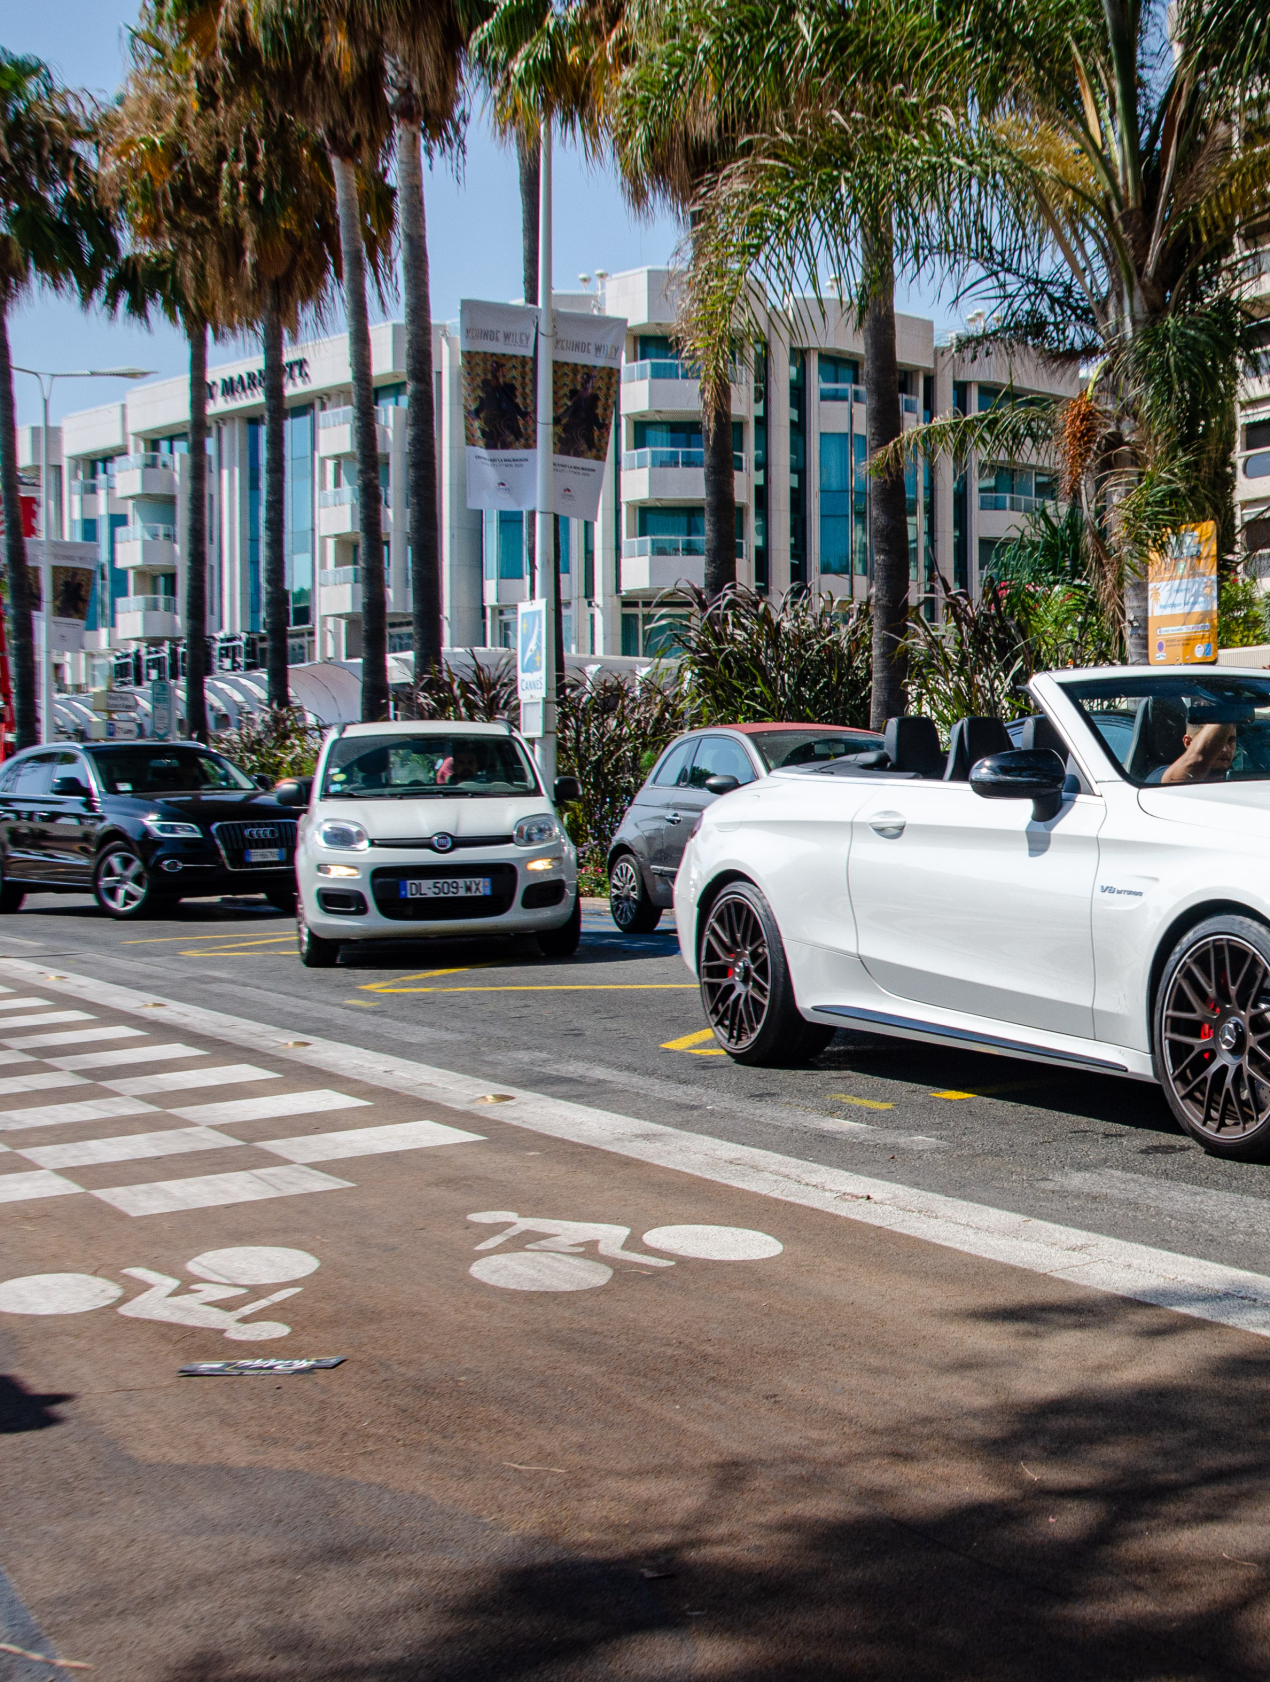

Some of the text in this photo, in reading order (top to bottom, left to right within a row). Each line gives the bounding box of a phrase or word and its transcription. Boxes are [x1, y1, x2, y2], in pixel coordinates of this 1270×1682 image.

[503, 330, 531, 344] WILEY
[521, 678, 543, 692] CANNES
[409, 880, 482, 897] DL-509-WX
